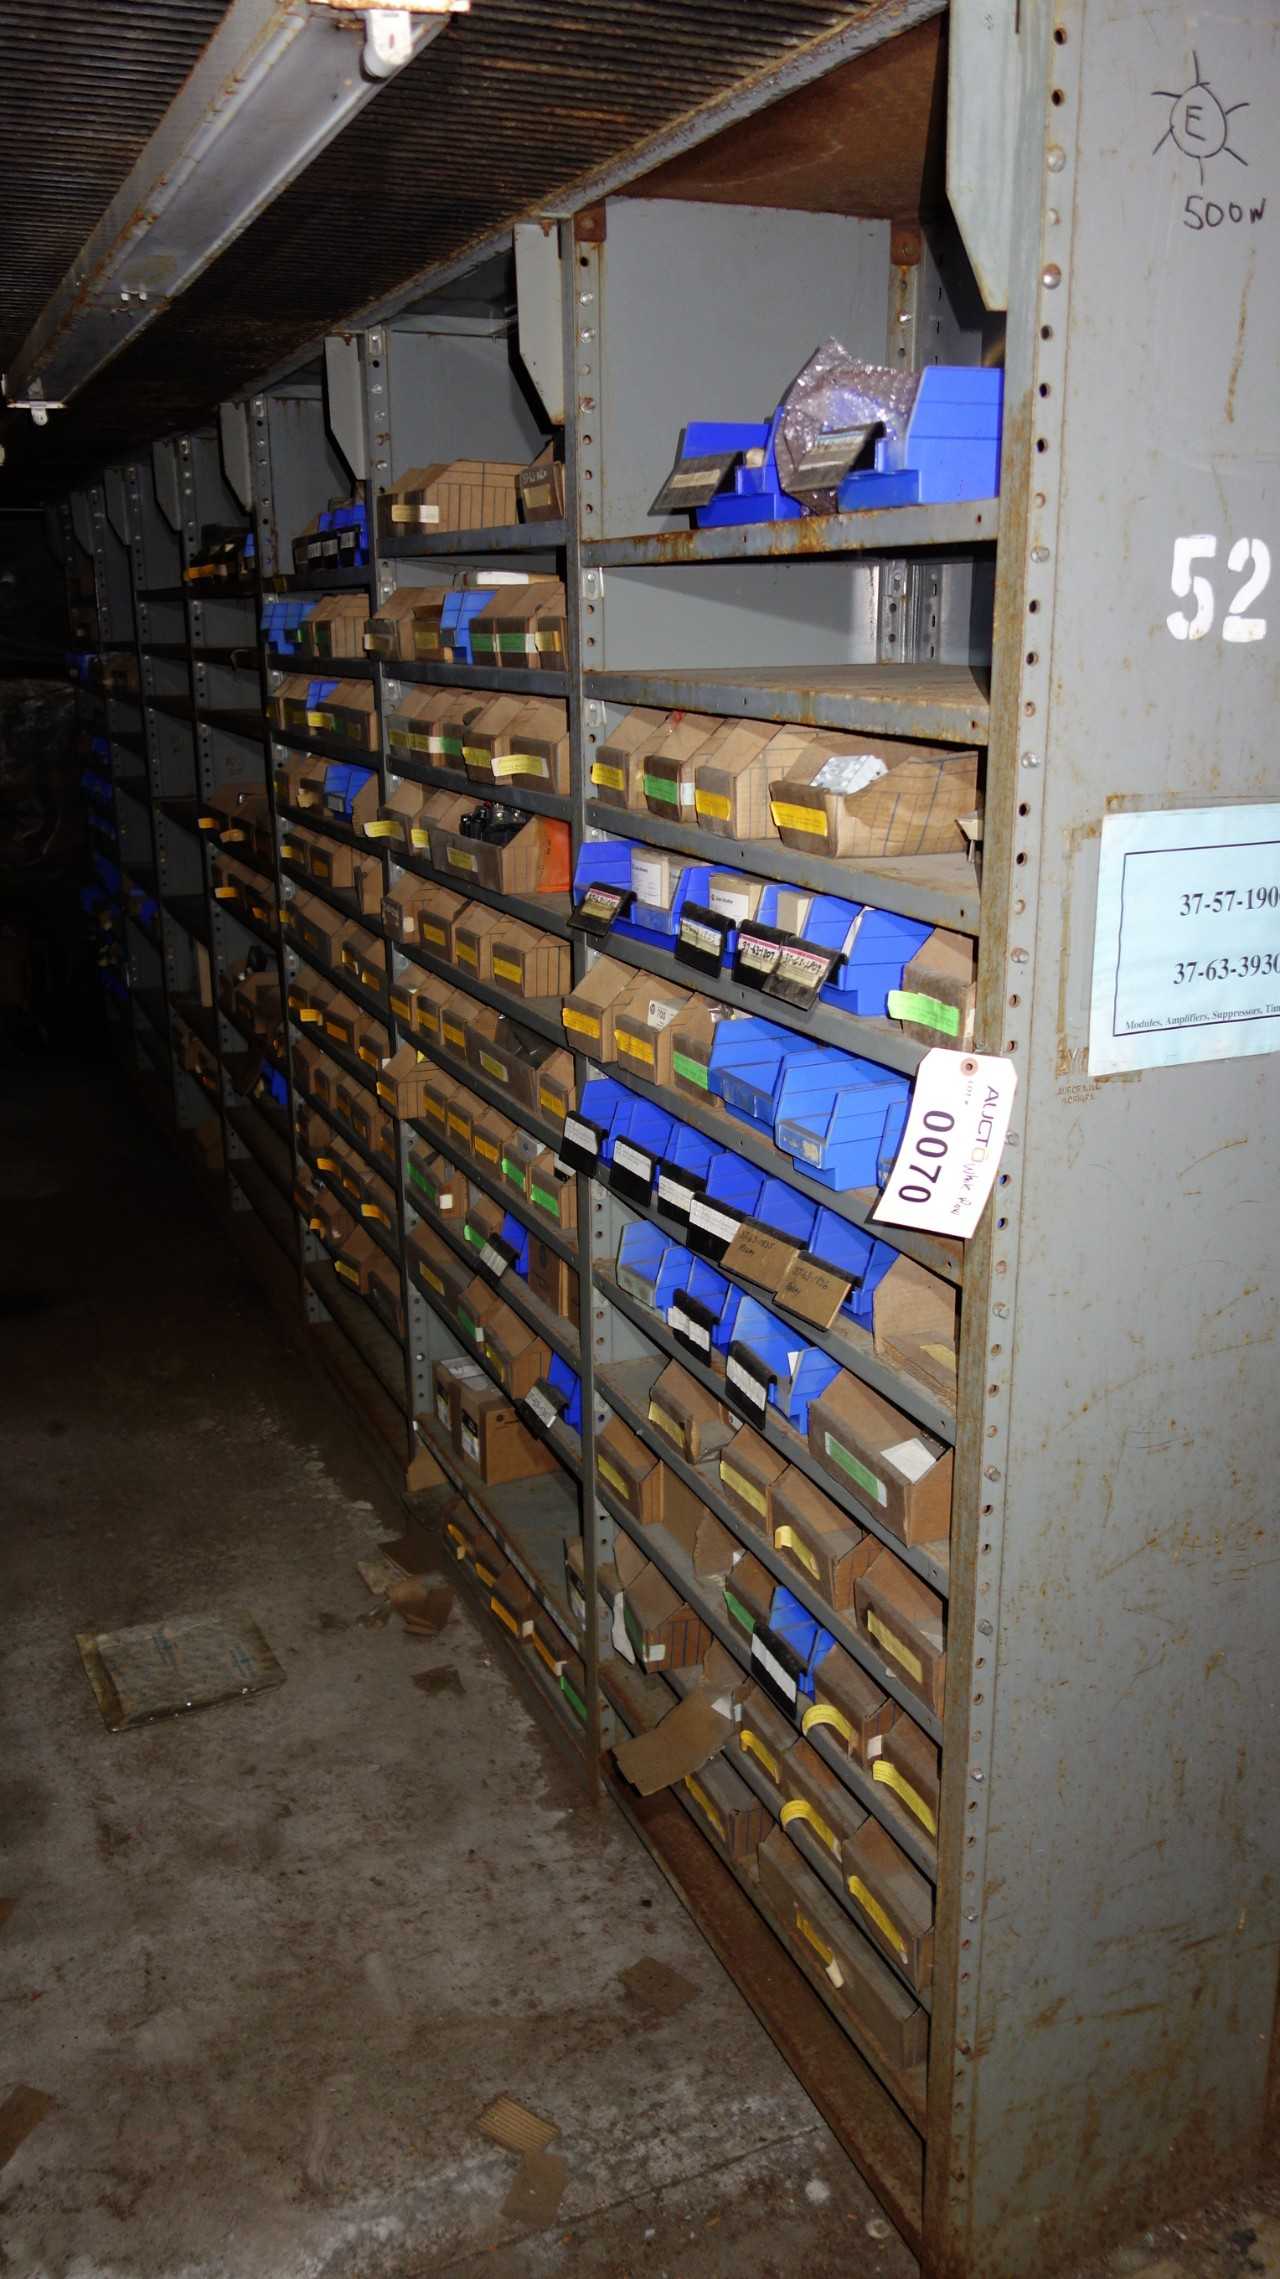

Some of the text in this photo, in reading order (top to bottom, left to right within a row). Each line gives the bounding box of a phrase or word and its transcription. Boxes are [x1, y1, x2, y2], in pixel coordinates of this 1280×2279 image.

[1184, 104, 1206, 142] E
[1165, 534, 1271, 643] 52
[1179, 886, 1280, 917] 37-57-190
[1166, 1012, 1210, 1027] Amplifiers,
[1212, 1005, 1263, 1021] Suppressors,
[898, 1110, 955, 1203] 0070
